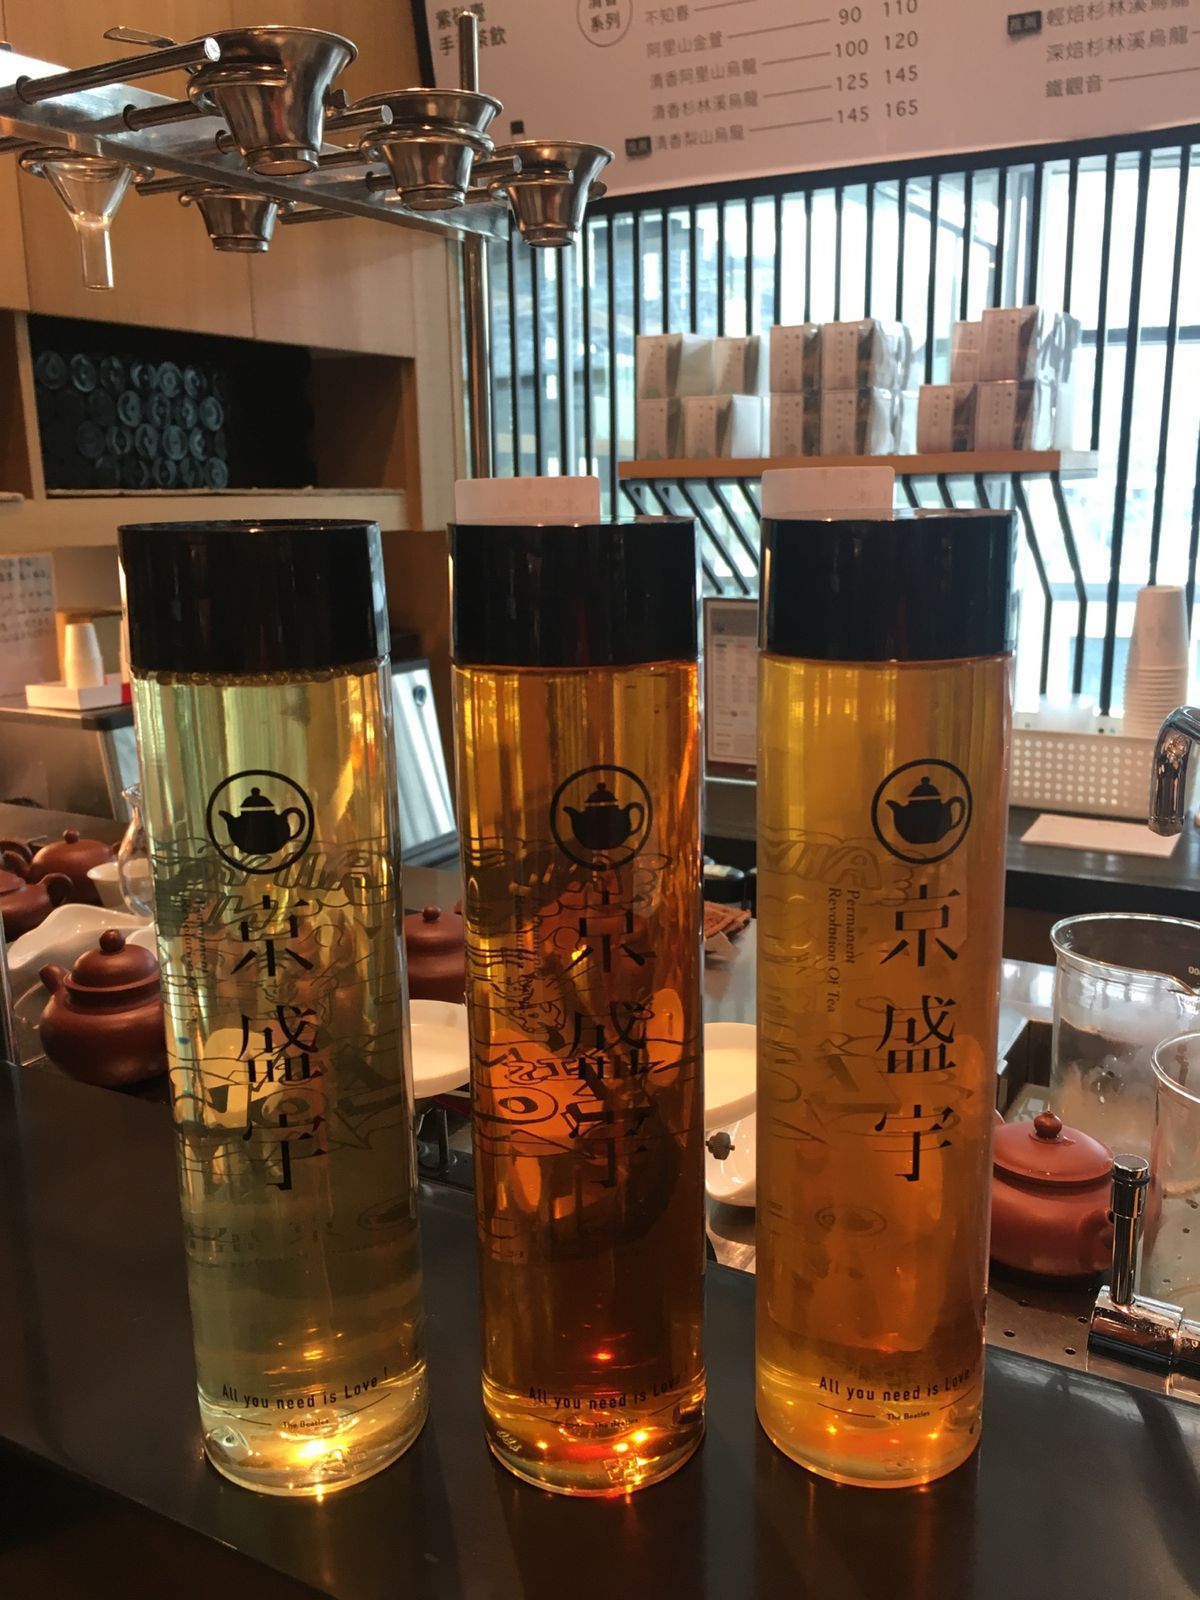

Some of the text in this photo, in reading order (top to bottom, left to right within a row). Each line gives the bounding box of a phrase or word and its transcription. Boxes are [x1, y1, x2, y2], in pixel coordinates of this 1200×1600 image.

[838, 6, 862, 25] 90
[883, 0, 918, 17] 110
[835, 38, 868, 58] 100
[885, 30, 918, 51] 120
[836, 72, 869, 92] 125
[885, 64, 918, 85] 145
[837, 105, 870, 124] 145
[885, 98, 918, 119] 165
[828, 887, 841, 961] Revolution
[846, 888, 860, 964] Permanent
[874, 884, 961, 1182] 京盛宇
[222, 1385, 238, 1402] All
[244, 1396, 269, 1409] you
[276, 1395, 316, 1410] need
[323, 1391, 337, 1406] is
[344, 1377, 378, 1399] Love
[528, 1387, 548, 1405] All
[554, 1396, 581, 1410] you
[589, 1395, 626, 1410] need
[634, 1390, 646, 1403] is
[819, 1376, 840, 1395] All
[847, 1387, 875, 1401] you
[883, 1385, 920, 1402] need
[928, 1383, 939, 1397] is
[945, 1368, 971, 1392] Love
[903, 1410, 930, 1420] Beatles
